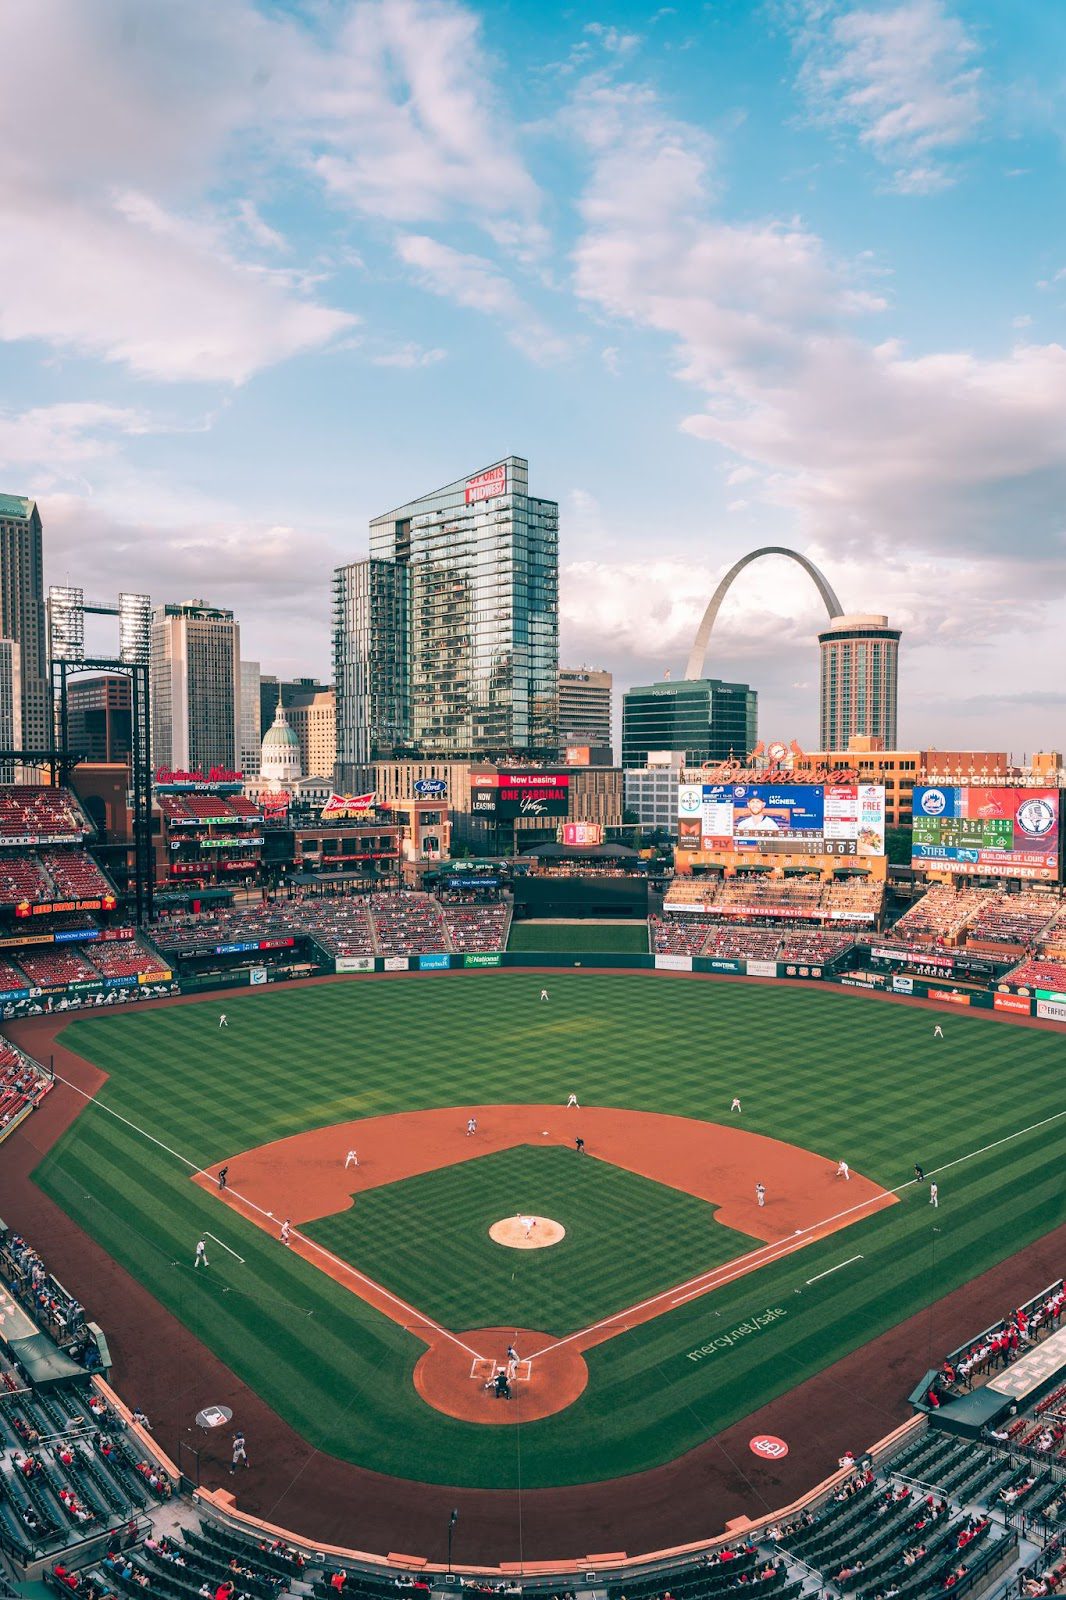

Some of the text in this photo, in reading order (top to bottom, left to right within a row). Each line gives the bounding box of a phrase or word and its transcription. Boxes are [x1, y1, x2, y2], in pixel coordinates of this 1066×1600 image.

[204, 766, 243, 784] Nation
[702, 760, 860, 784] Budweiser
[510, 776, 556, 786] Now Leasing
[928, 775, 1045, 786] WORLD CHAMPIONS
[421, 781, 441, 791] Ford
[477, 793, 491, 801] NOW
[501, 790, 566, 800] ONE CARDINAL
[322, 797, 376, 809] Budweiser
[473, 802, 496, 811] LEASING
[519, 796, 548, 815] Way
[863, 802, 881, 811] FREE
[323, 809, 376, 820] BREW HOUSE
[712, 840, 730, 848] FLY
[827, 845, 855, 853] 0 0 2
[921, 846, 947, 857] STIFEL
[981, 852, 1012, 861] BUILDING
[1013, 853, 1023, 861] ST.
[1024, 854, 1044, 863] LOUIS
[930, 861, 967, 872] BROWN
[977, 864, 1035, 877] CROUPPEN
[33, 900, 101, 915] BIG MAC LAND
[55, 933, 79, 941] WINDOW
[79, 931, 98, 939] NATION
[473, 955, 499, 963] National
[75, 983, 92, 991] Central
[686, 1308, 788, 1362] mercy.net/safe
